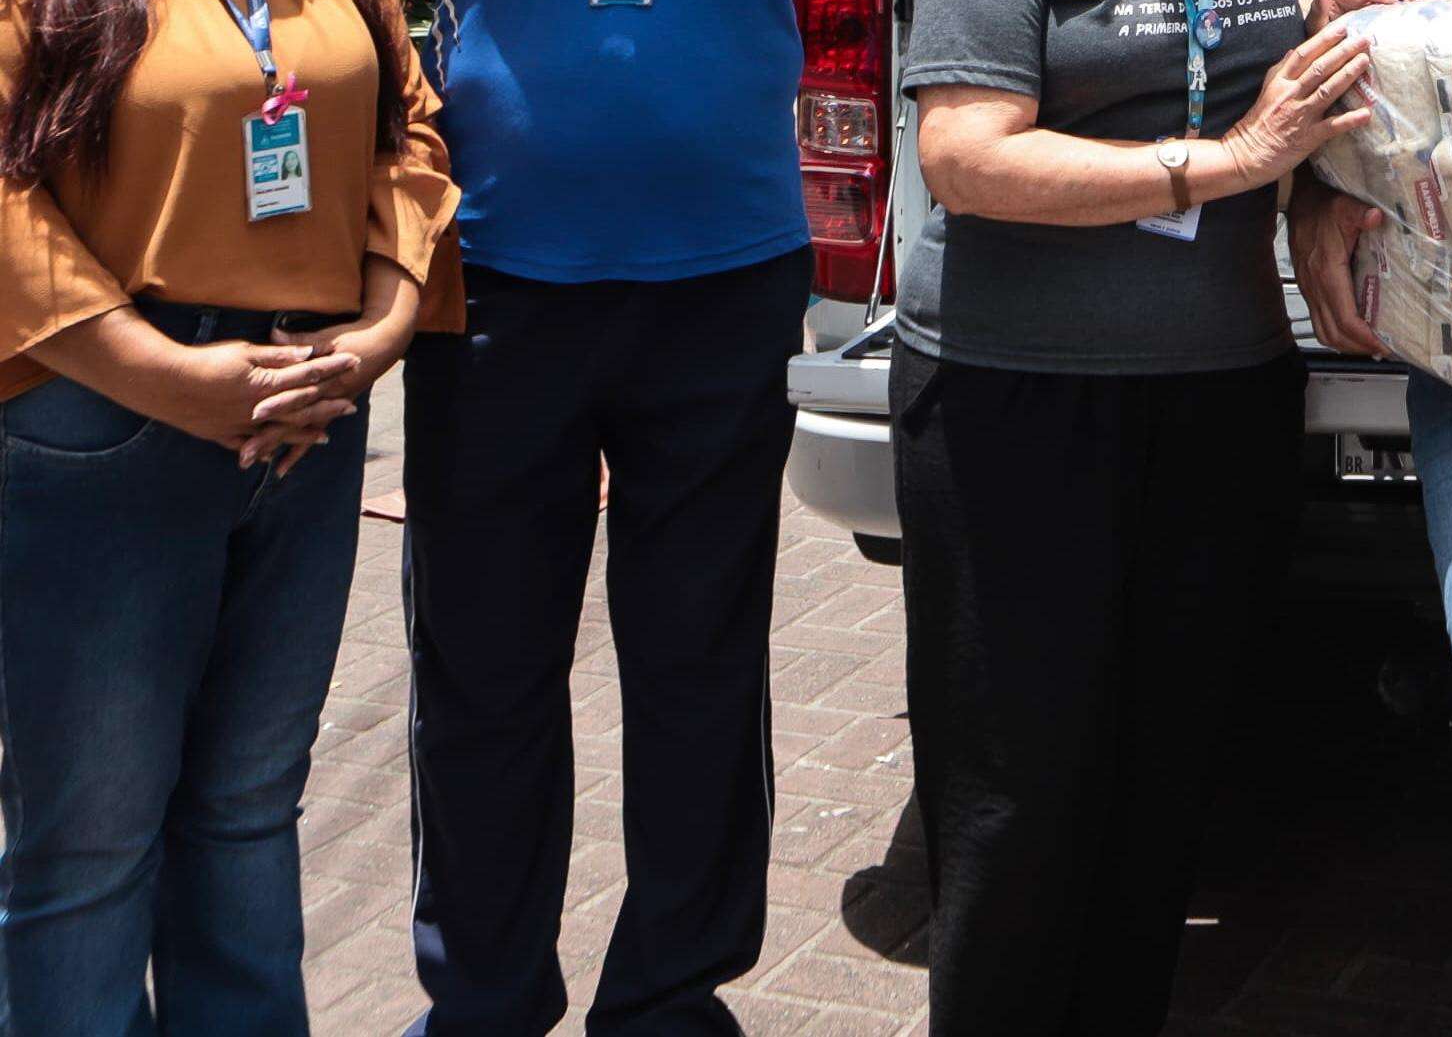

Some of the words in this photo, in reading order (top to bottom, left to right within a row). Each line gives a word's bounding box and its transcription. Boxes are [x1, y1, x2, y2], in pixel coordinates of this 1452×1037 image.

[1114, 4, 1133, 16] NA
[1139, 2, 1175, 15] TERRA
[1118, 24, 1130, 37] A
[1135, 22, 1188, 37] PRIMEIRA
[1345, 456, 1362, 472] BR
